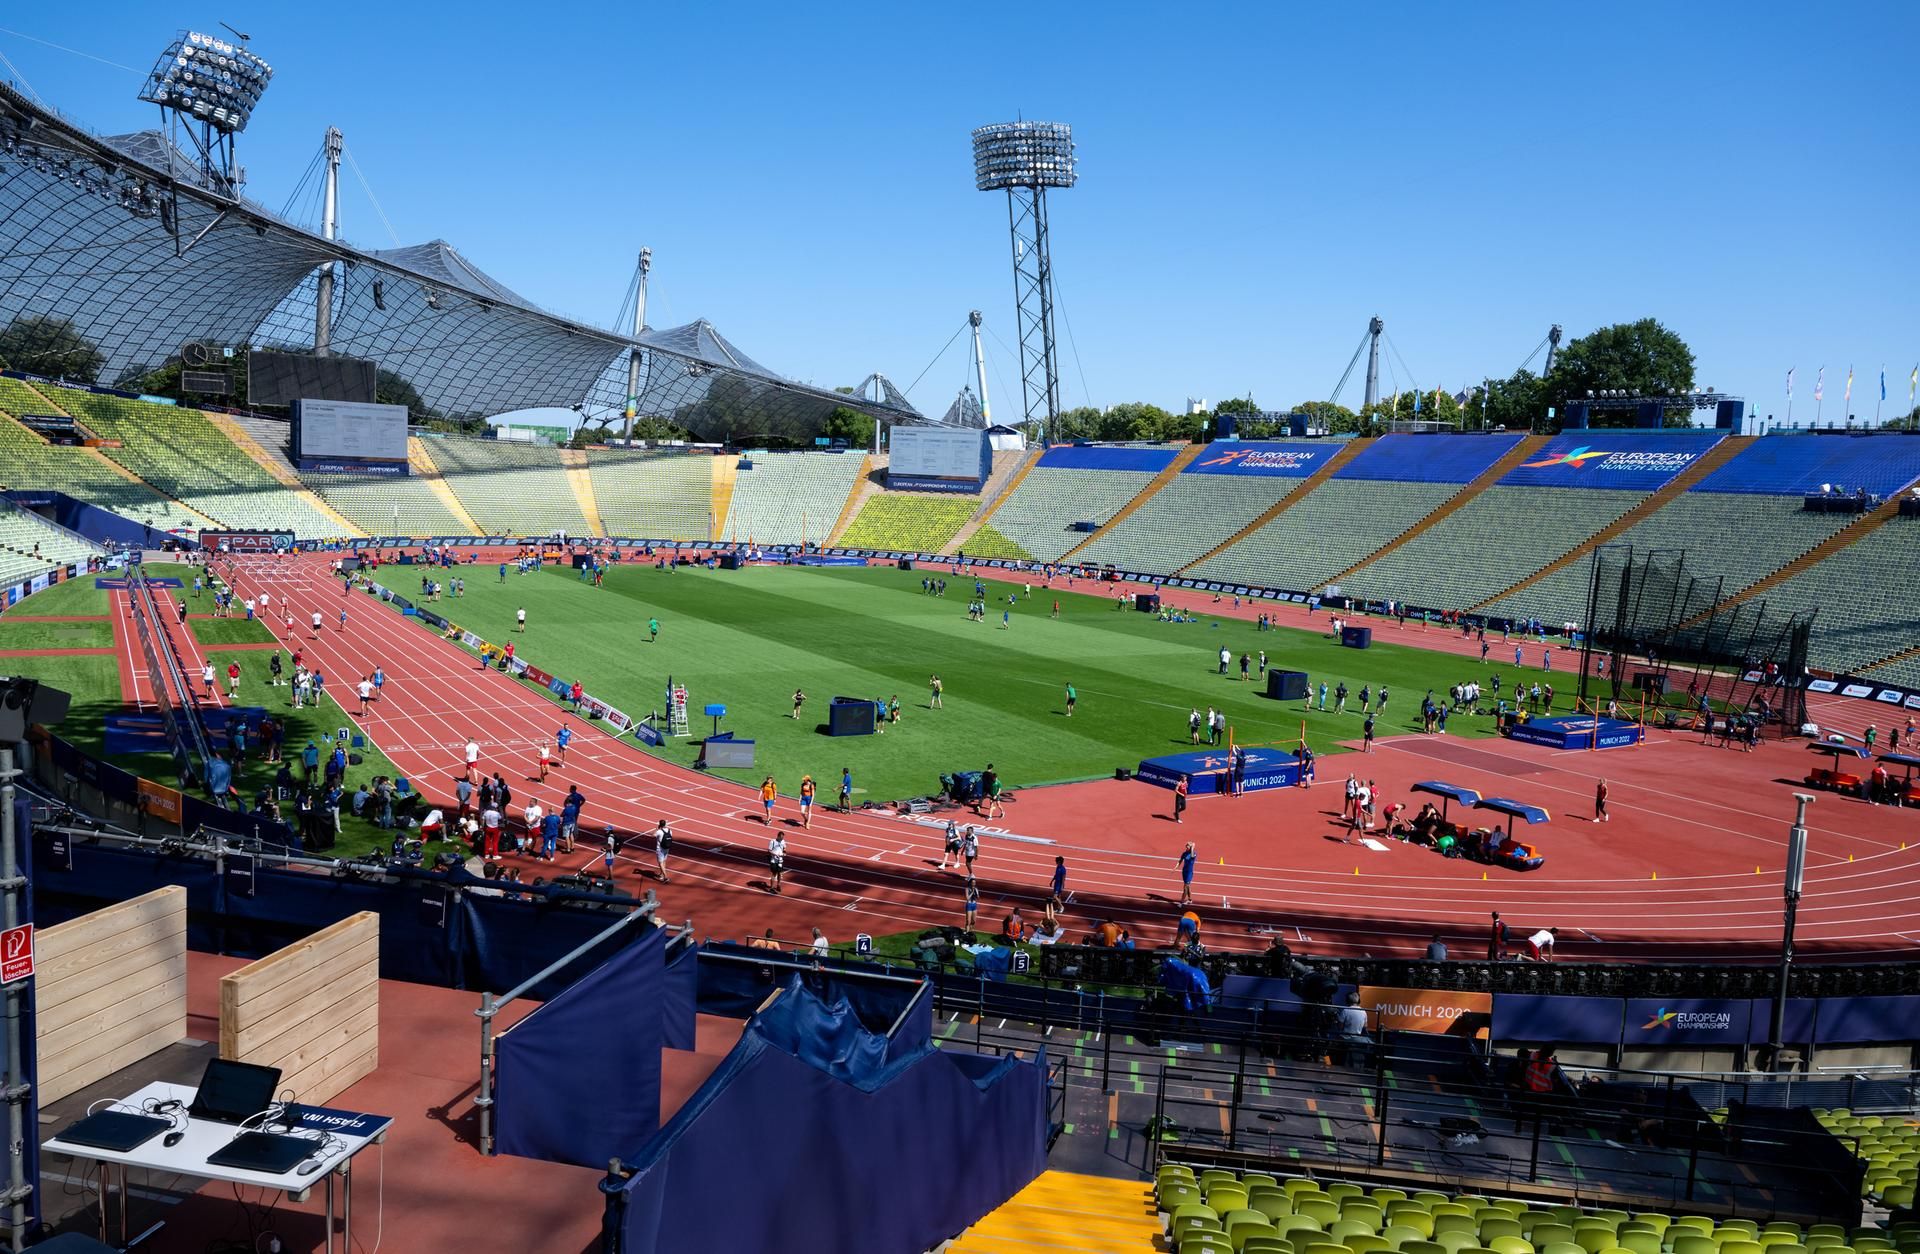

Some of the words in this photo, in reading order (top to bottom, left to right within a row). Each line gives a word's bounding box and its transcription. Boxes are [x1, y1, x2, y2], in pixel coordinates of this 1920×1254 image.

[1244, 451, 1315, 459] EUROPEAN
[1609, 452, 1696, 461] EUROPEAN
[219, 537, 271, 546] SPAR
[1600, 737, 1618, 745] MUNICH
[1619, 735, 1630, 743] 2022
[1242, 777, 1267, 788] MUNICH
[1269, 774, 1286, 784] 2022
[163, 798, 175, 810] 2022
[860, 941, 867, 951] 4
[6, 961, 28, 971] Feuer-
[1018, 959, 1025, 968] 5
[4, 967, 31, 980] löscher
[1376, 1003, 1432, 1018] MUNICH
[1677, 1013, 1730, 1022] EUROPEAN
[324, 1116, 366, 1128] FLASH
